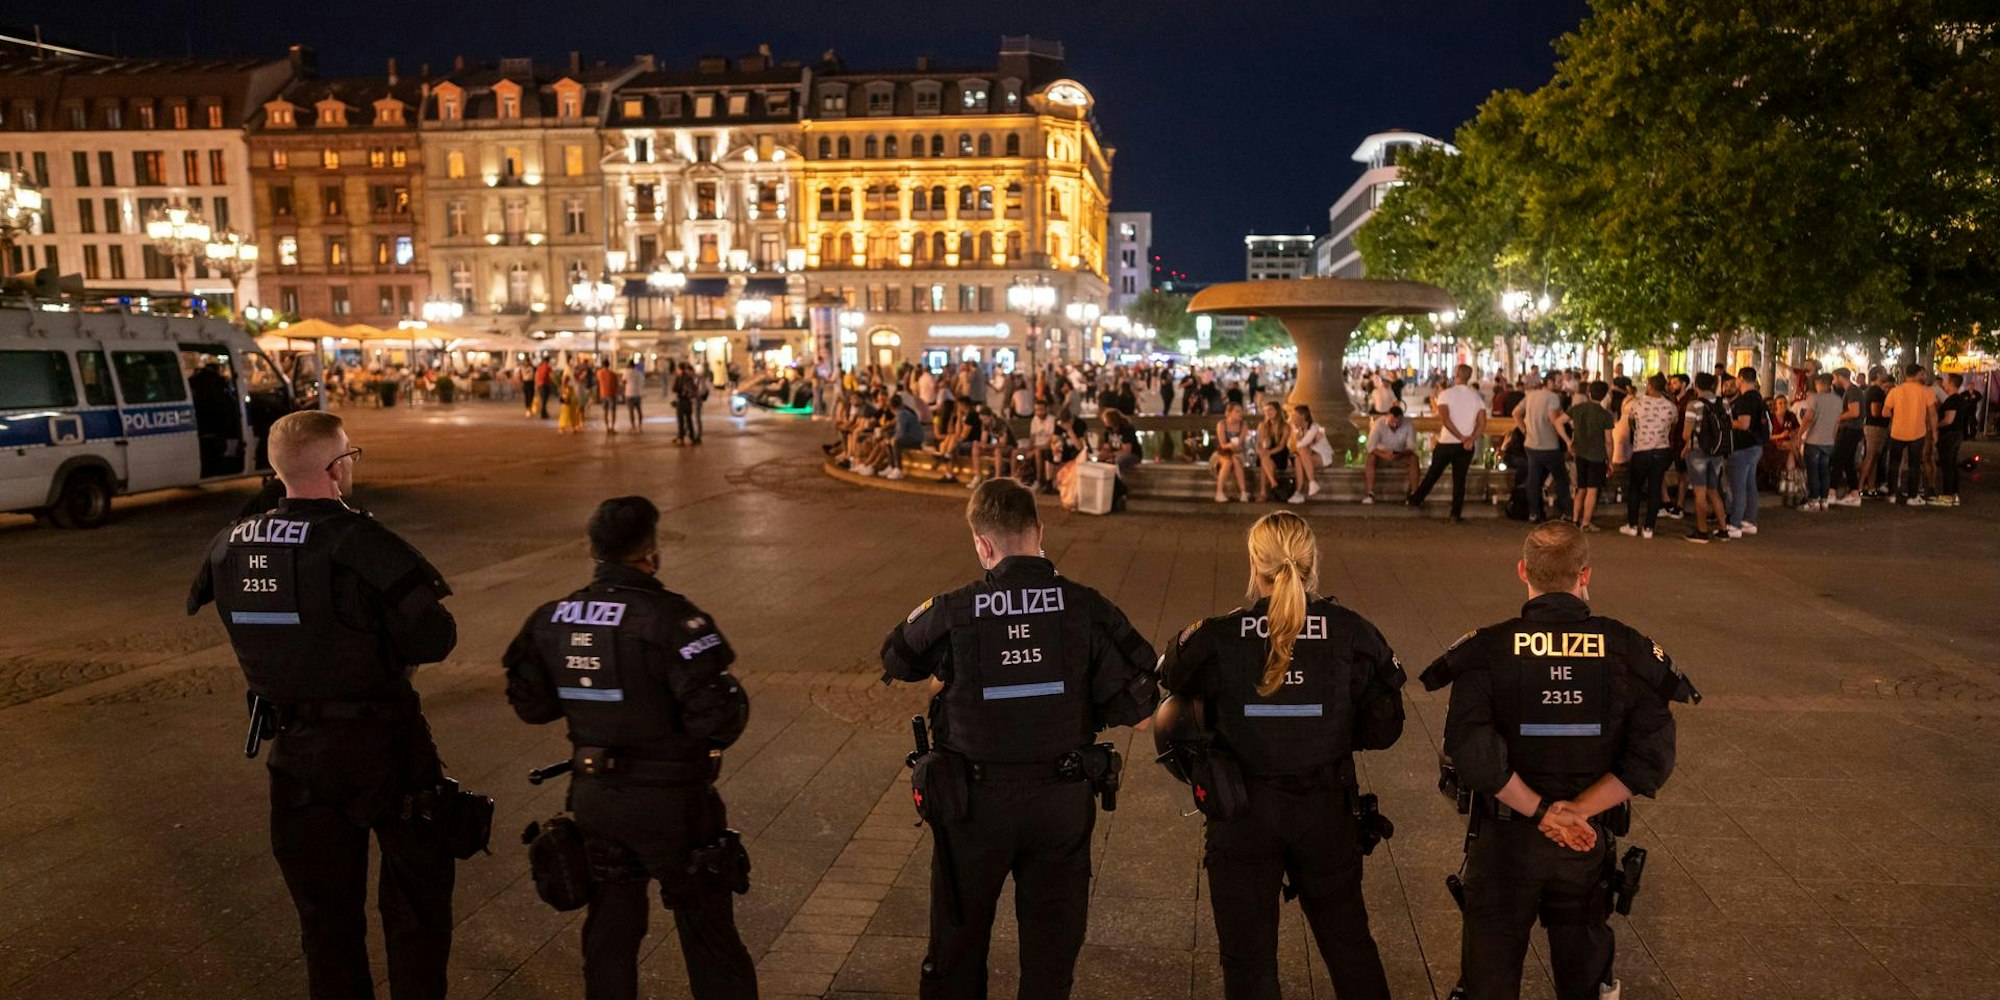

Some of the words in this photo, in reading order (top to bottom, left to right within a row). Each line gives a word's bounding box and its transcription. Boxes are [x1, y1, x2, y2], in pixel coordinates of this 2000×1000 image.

[122, 411, 181, 430] POLIZEI
[229, 519, 310, 544] POLIZEI
[249, 554, 268, 569] HE
[242, 578, 278, 592] 2315
[974, 587, 1065, 618] POLIZEI
[550, 600, 627, 626] POLIZEI
[1007, 624, 1031, 640] HE
[1241, 615, 1328, 640] POEI
[570, 632, 593, 647] HE
[1513, 631, 1605, 657] POLIZEI
[565, 655, 601, 670] 2315
[1001, 648, 1043, 666] 2315
[1550, 665, 1573, 680] HE
[1541, 690, 1584, 705] 2315
